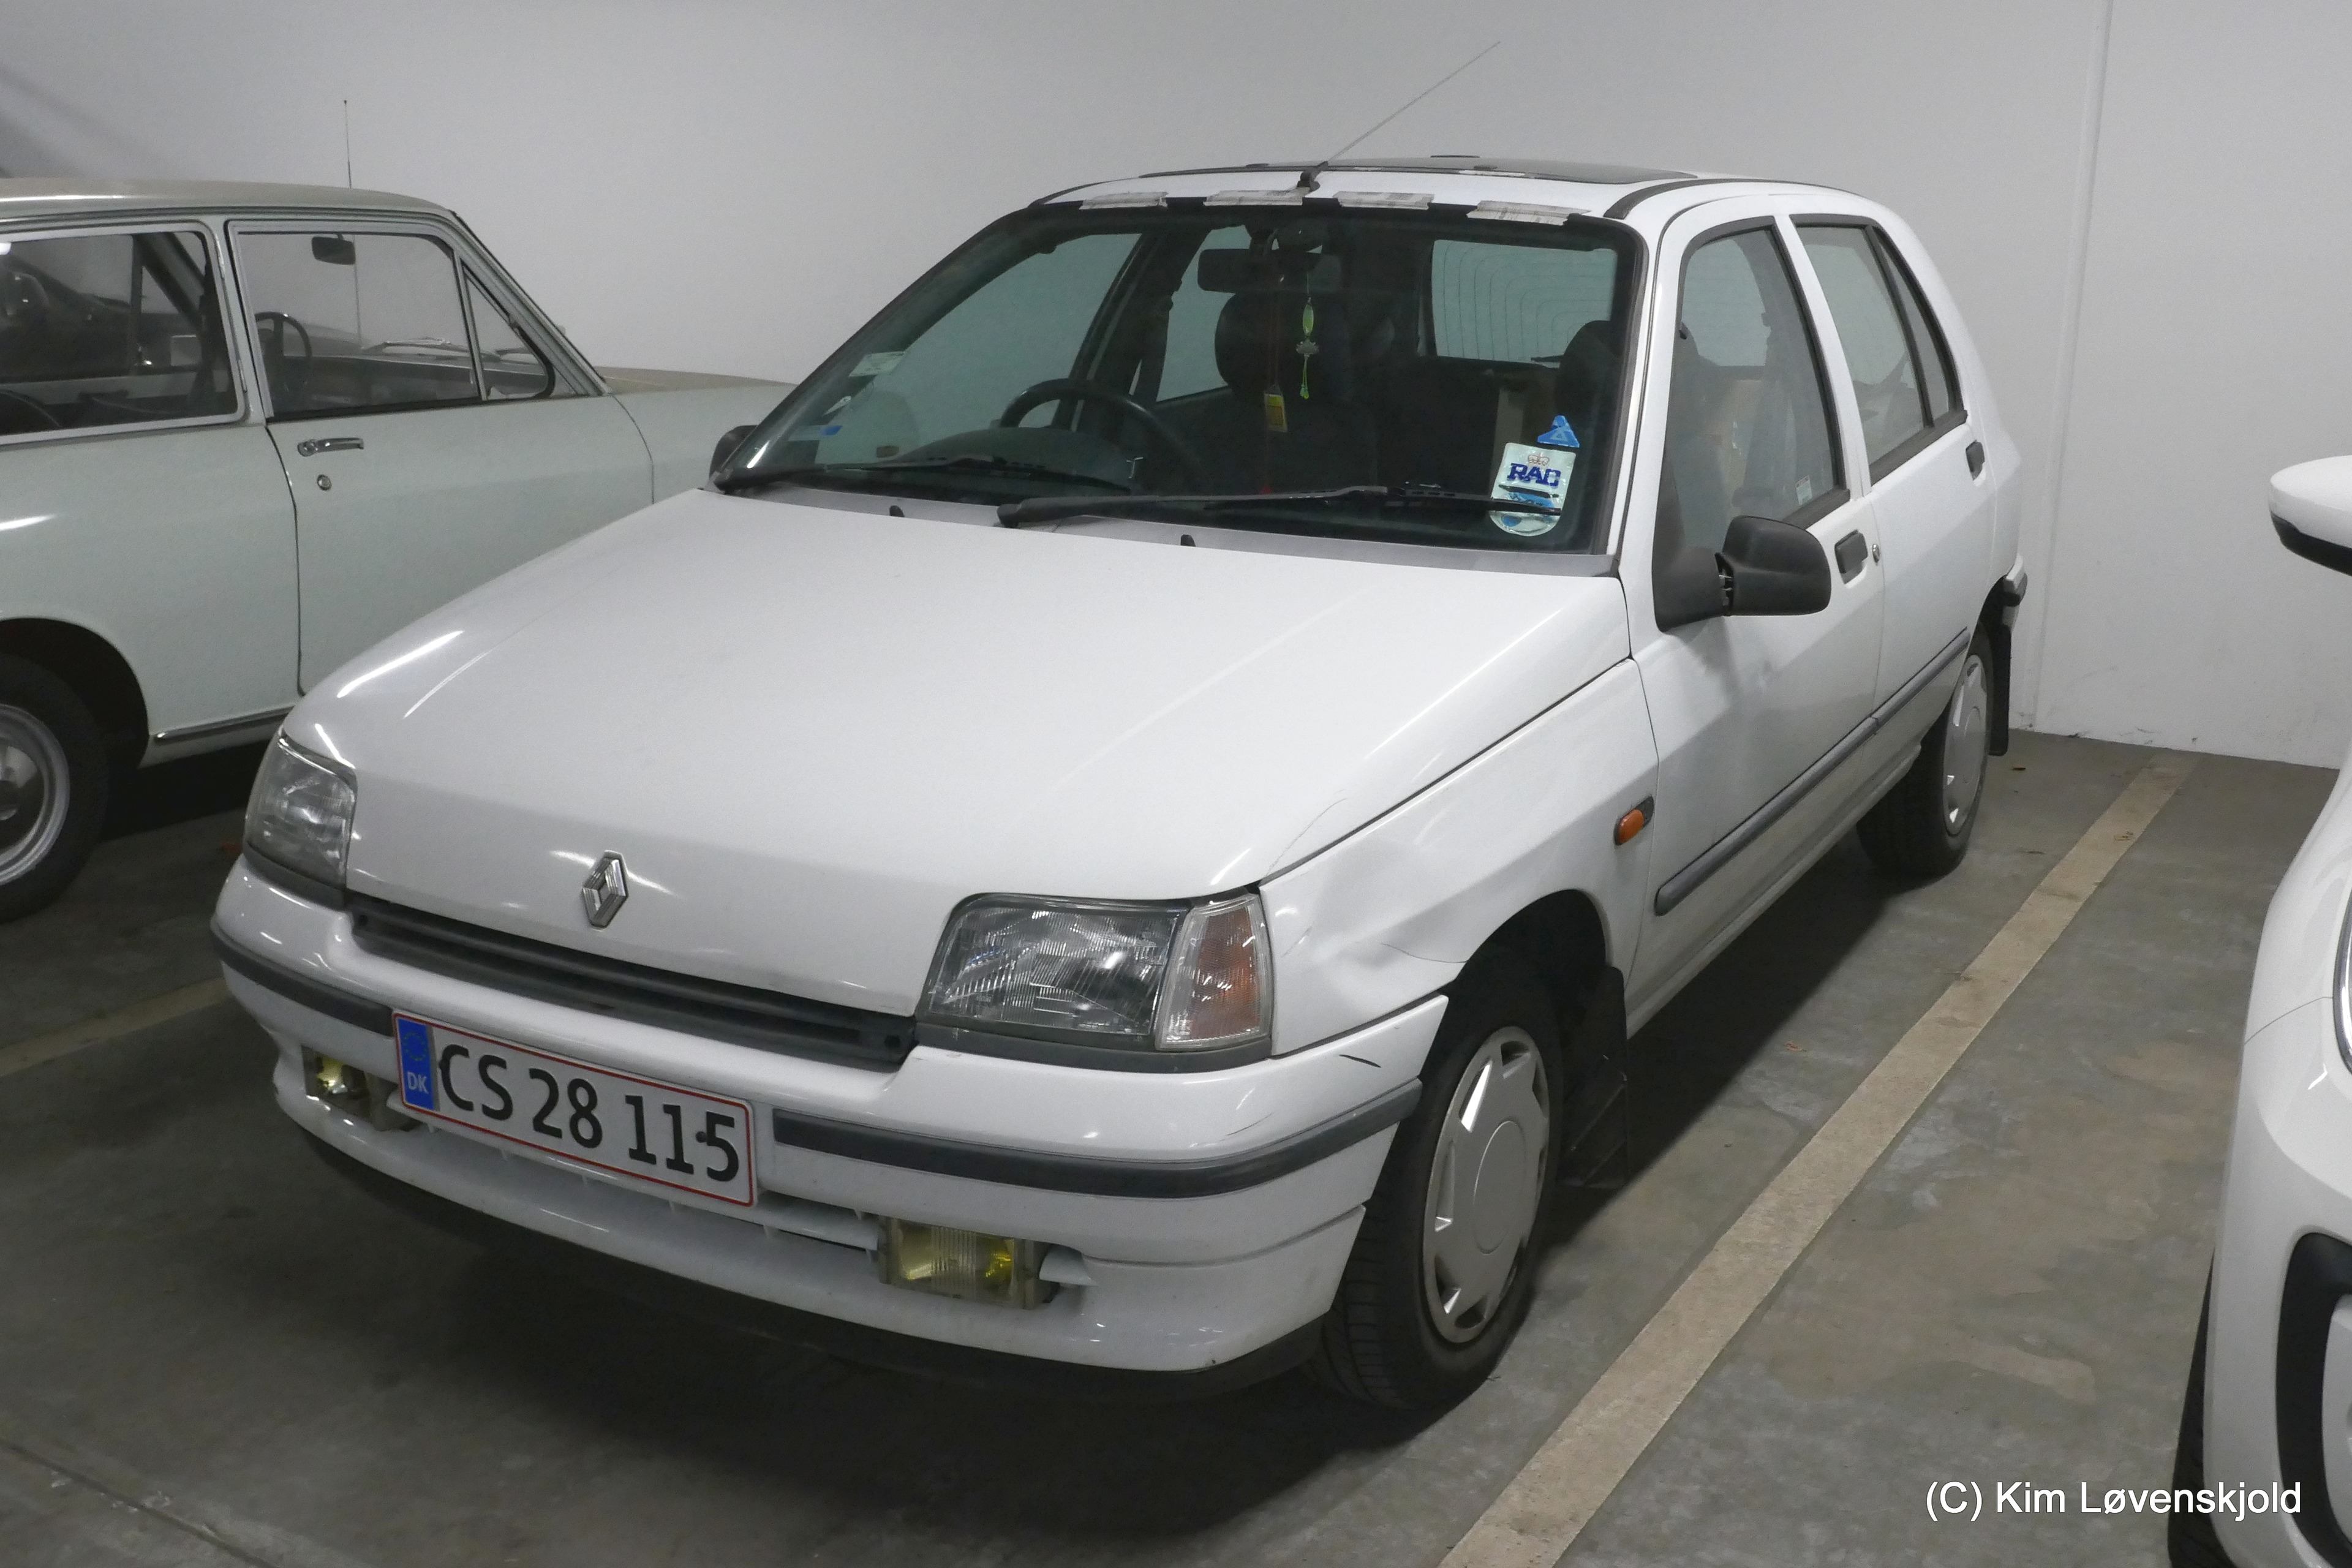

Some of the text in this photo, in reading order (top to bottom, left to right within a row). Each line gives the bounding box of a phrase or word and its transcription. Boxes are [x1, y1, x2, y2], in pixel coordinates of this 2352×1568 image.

[1507, 462, 1561, 486] RAC
[407, 1071, 429, 1095] DK
[439, 1044, 739, 1182] CS 28 115
